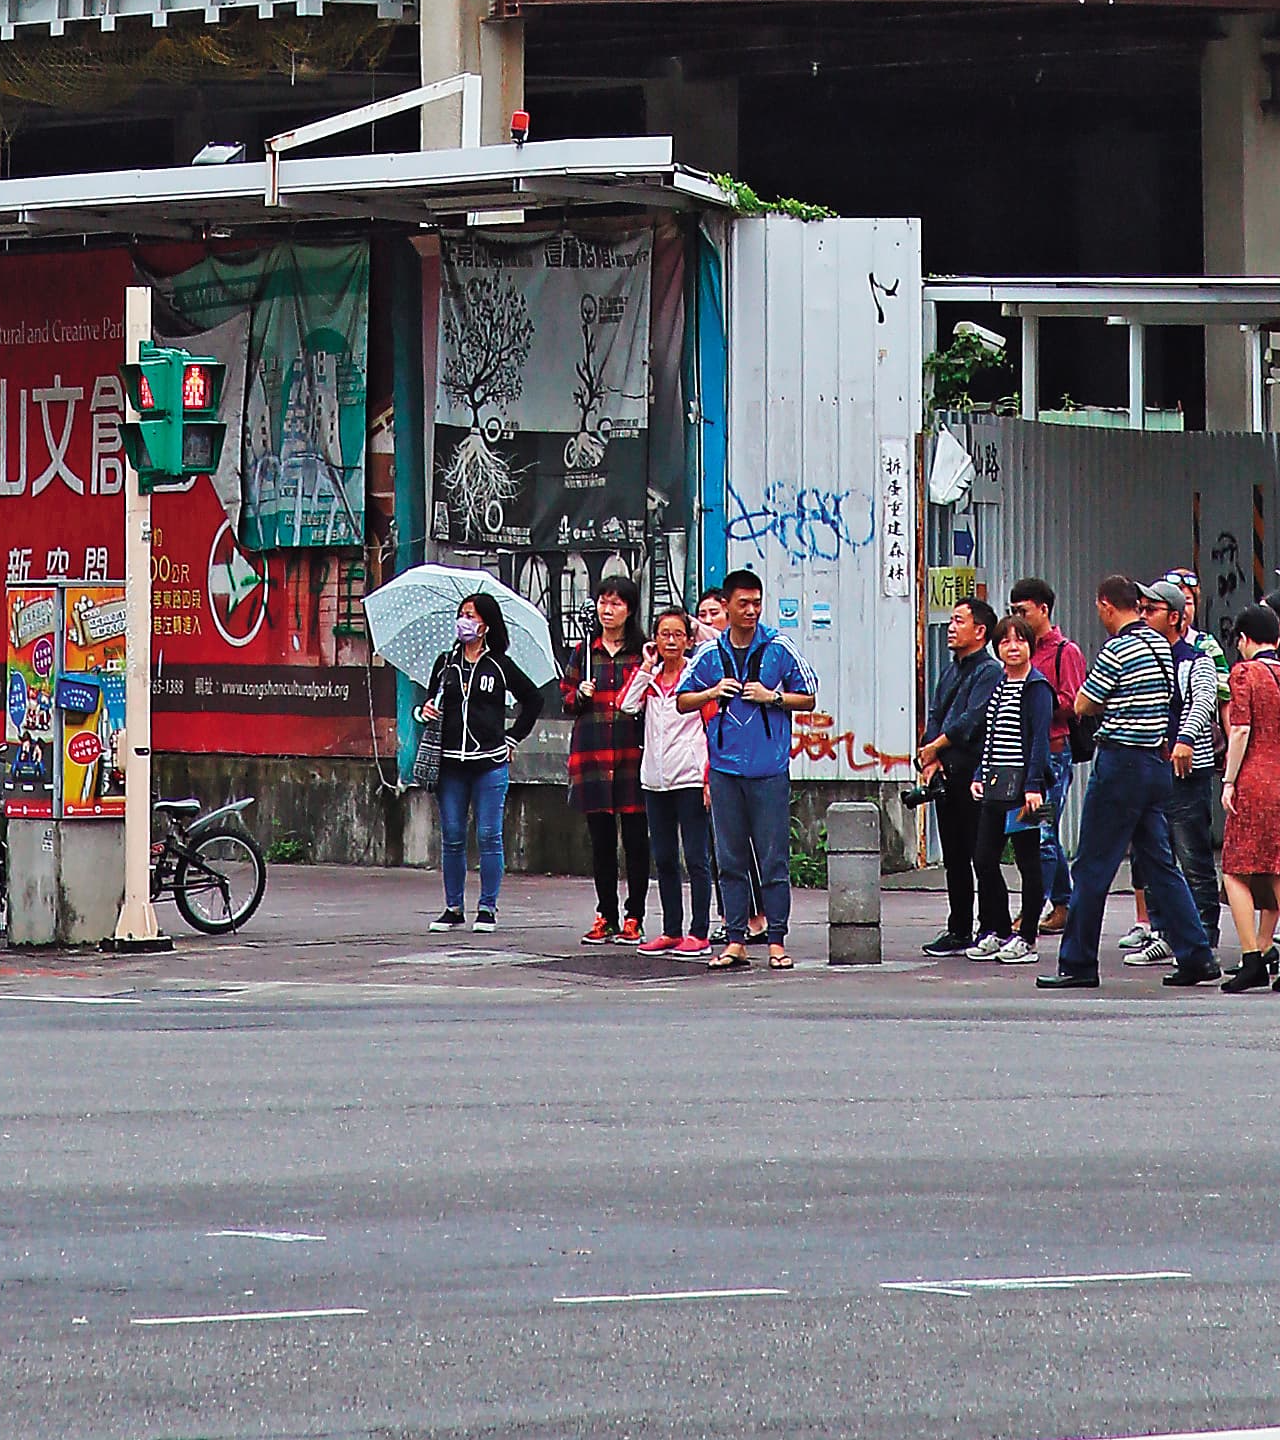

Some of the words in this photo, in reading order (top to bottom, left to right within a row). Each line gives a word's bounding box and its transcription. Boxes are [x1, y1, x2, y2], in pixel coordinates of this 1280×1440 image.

[27, 320, 50, 344] and
[52, 318, 99, 343] Creative
[480, 674, 495, 693] 08
